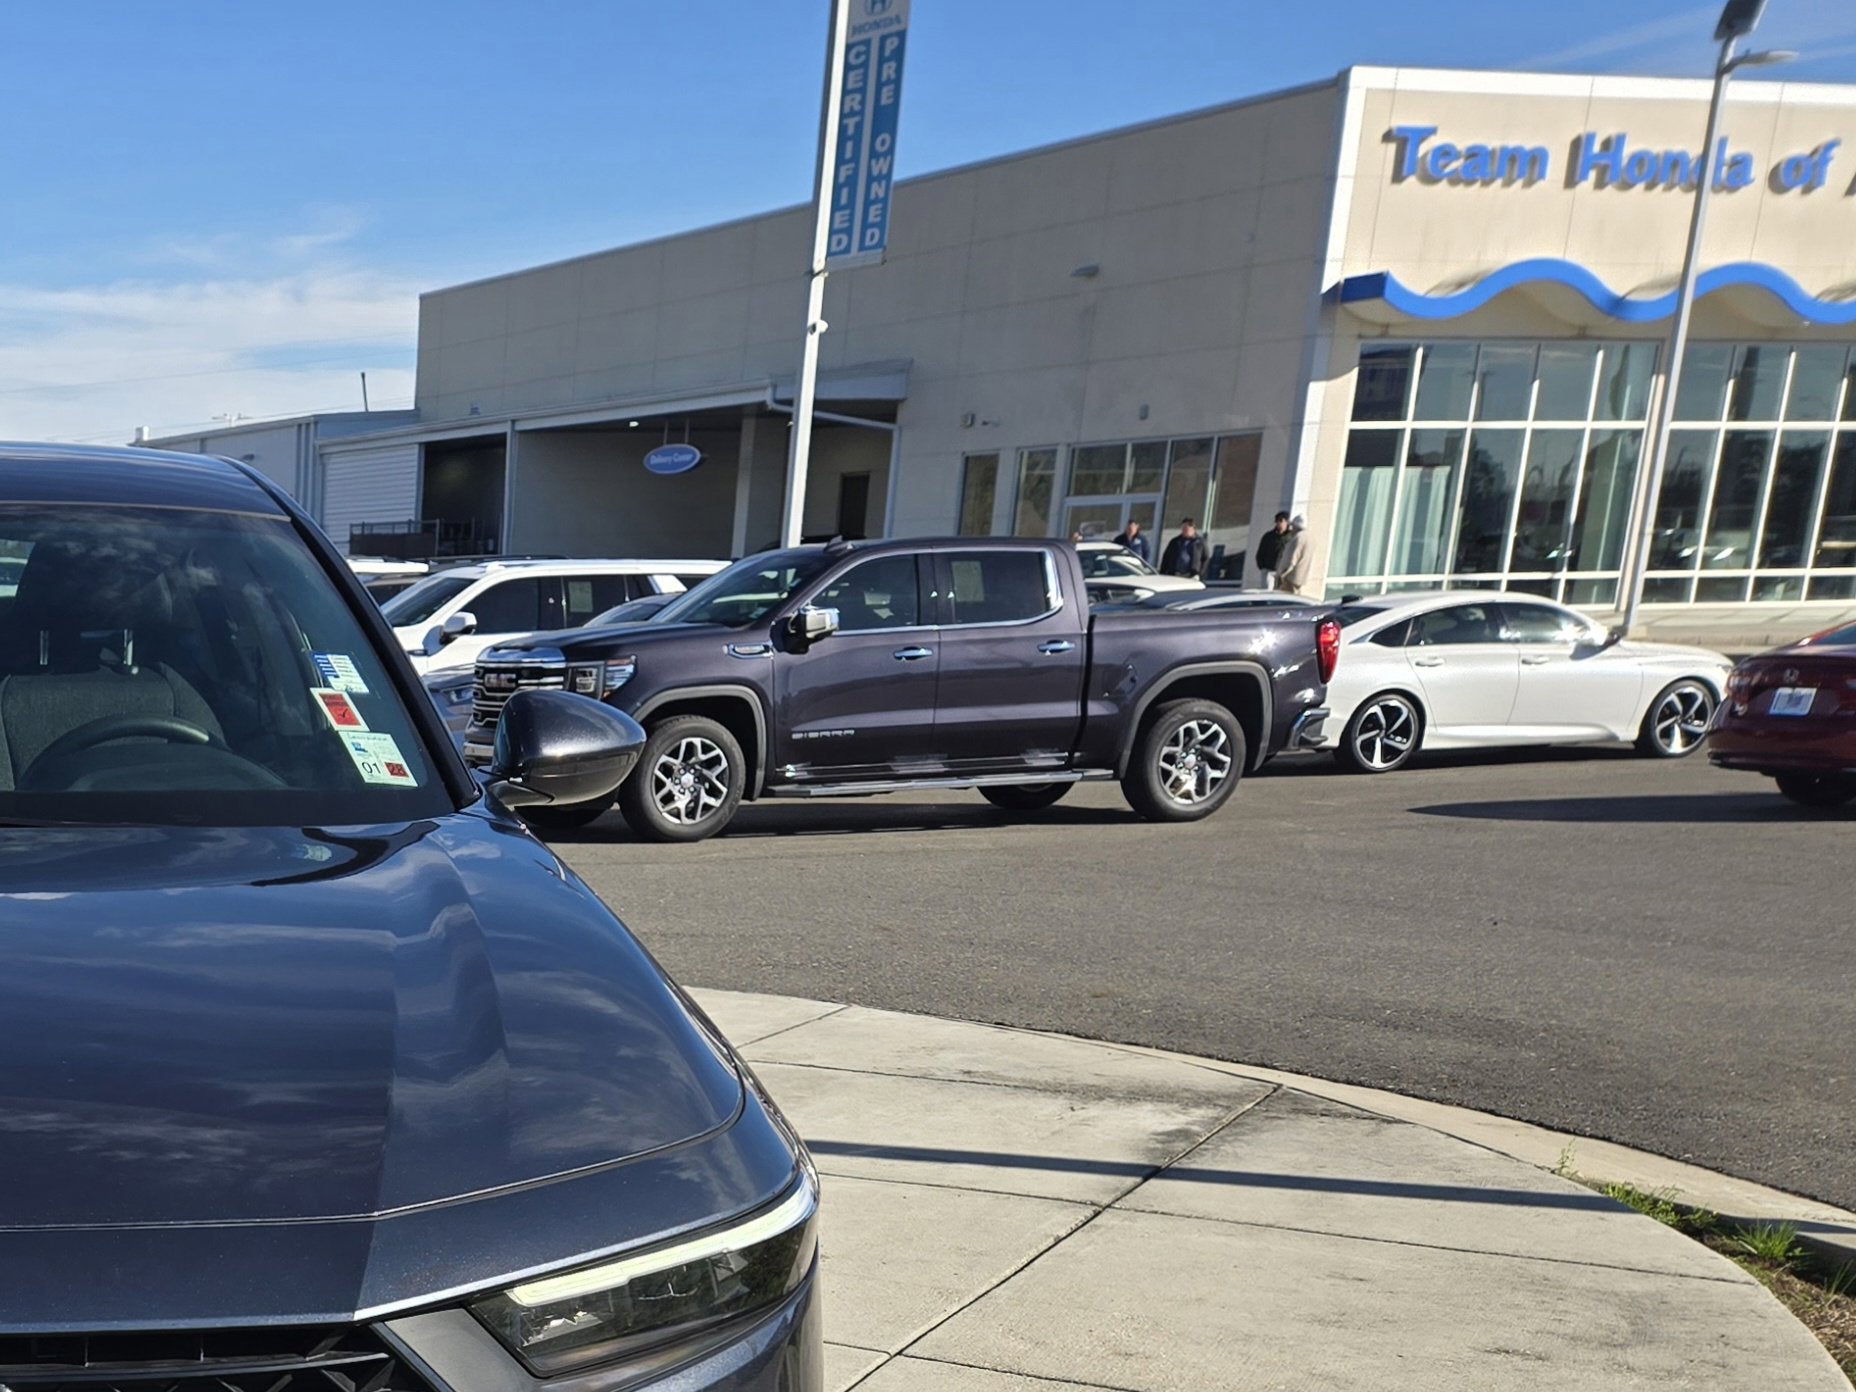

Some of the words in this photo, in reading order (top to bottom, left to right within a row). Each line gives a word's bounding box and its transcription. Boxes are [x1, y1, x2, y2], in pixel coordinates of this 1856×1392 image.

[880, 37, 899, 106] PRE
[831, 45, 866, 252] CERTIFIED
[1394, 125, 1550, 181] Team
[1778, 138, 1842, 188] of
[865, 133, 892, 246] OWNED
[361, 761, 381, 774] 01
